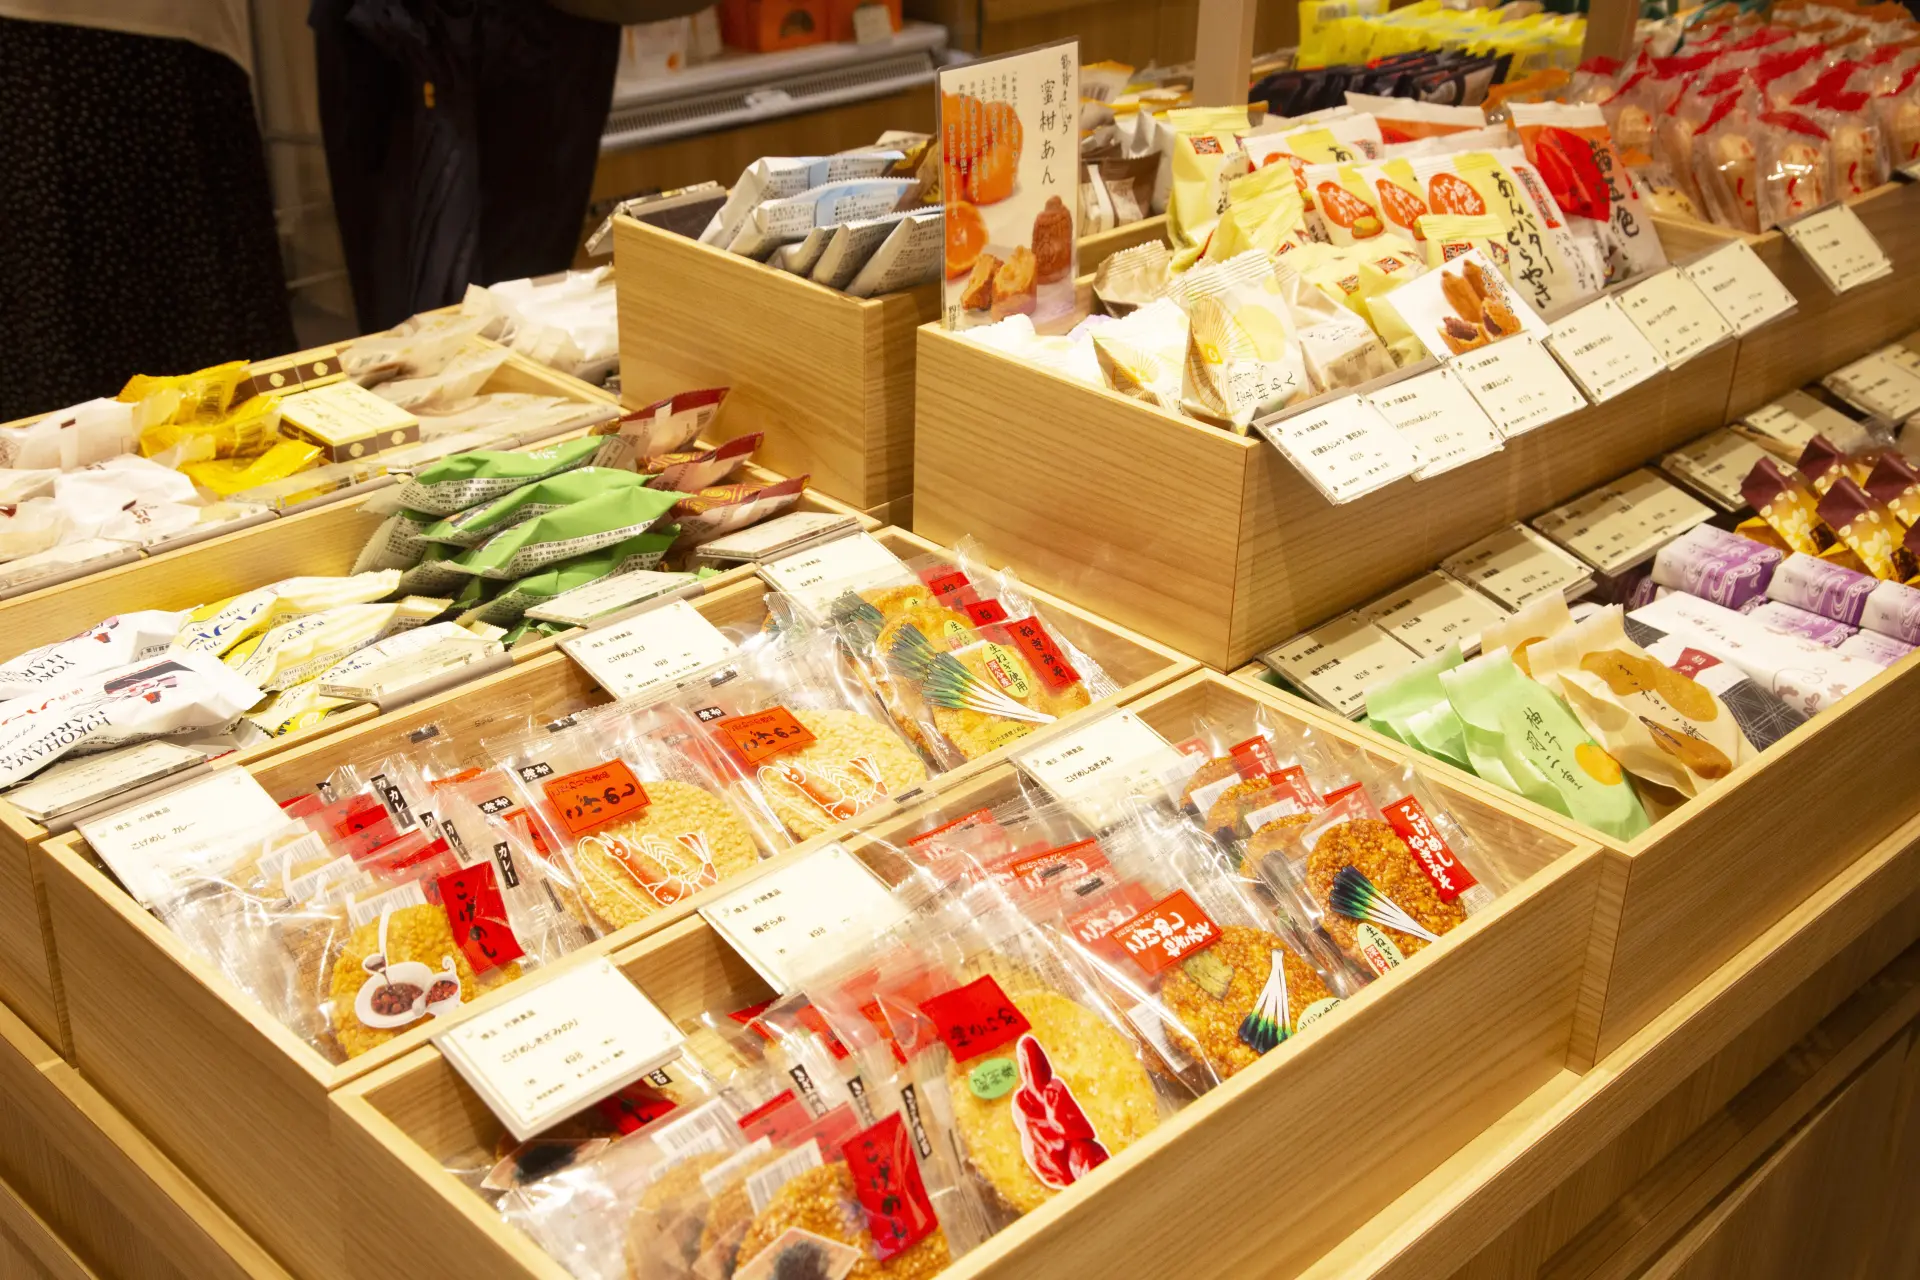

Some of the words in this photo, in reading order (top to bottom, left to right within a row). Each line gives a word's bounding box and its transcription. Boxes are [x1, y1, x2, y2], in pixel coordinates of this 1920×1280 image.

[1040, 79, 1056, 185] 蜜柑あん
[1490, 171, 1554, 275] あんバター
[1507, 226, 1552, 309] どらやき
[608, 645, 646, 664] こげめしえび
[653, 659, 669, 668] ¥98
[989, 643, 1030, 693] 生ねぎ使用
[1019, 625, 1067, 679] ねぎみそ
[988, 660, 1013, 688] 深谷産
[1354, 669, 1371, 681] ¥216
[699, 708, 723, 720] 海老
[4, 716, 113, 772] YOKOHAMA
[742, 724, 801, 752] こげめし
[522, 765, 550, 780] 海老
[1064, 756, 1114, 783] こげめしねぎみそ
[483, 797, 509, 813] 海老
[566, 783, 636, 820] こげめし
[131, 832, 166, 850] こげめし
[171, 821, 196, 835] カレー
[1400, 805, 1454, 867] こげめし
[498, 845, 516, 885] カレー
[1408, 835, 1455, 891] ねぎみそ
[454, 881, 498, 959] こげめし
[752, 915, 786, 934] 梅ざらめ
[808, 926, 827, 938] ¥98
[1126, 911, 1185, 955] こげめし
[1162, 921, 1212, 957] ねぎみそ
[501, 1018, 579, 1064] こげめしきざみのり
[564, 1051, 584, 1065] ¥98
[973, 1062, 1016, 1092] 紀州産
[864, 1141, 908, 1239] こげめし
